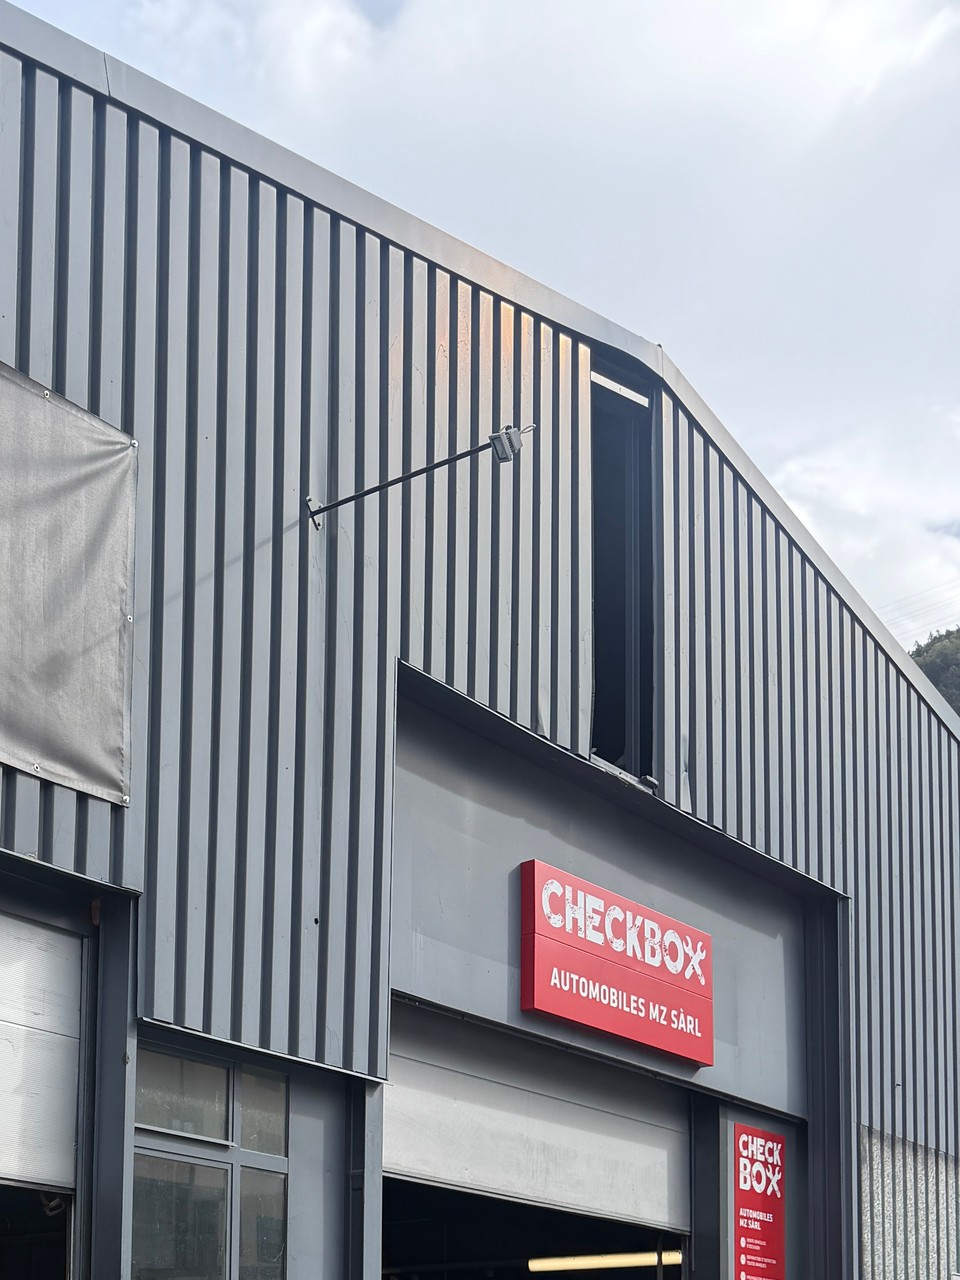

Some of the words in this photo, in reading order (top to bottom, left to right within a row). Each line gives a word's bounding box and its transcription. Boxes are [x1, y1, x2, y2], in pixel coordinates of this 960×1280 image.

[541, 878, 707, 986] CHECKBOX
[550, 967, 646, 1018] AUTOMOBILES
[649, 1001, 668, 1026] MZ
[670, 1007, 702, 1038] SÀRL
[738, 1133, 782, 1166] CHECK
[739, 1157, 782, 1199] BOX
[739, 1207, 774, 1223] AUTOMOBILES
